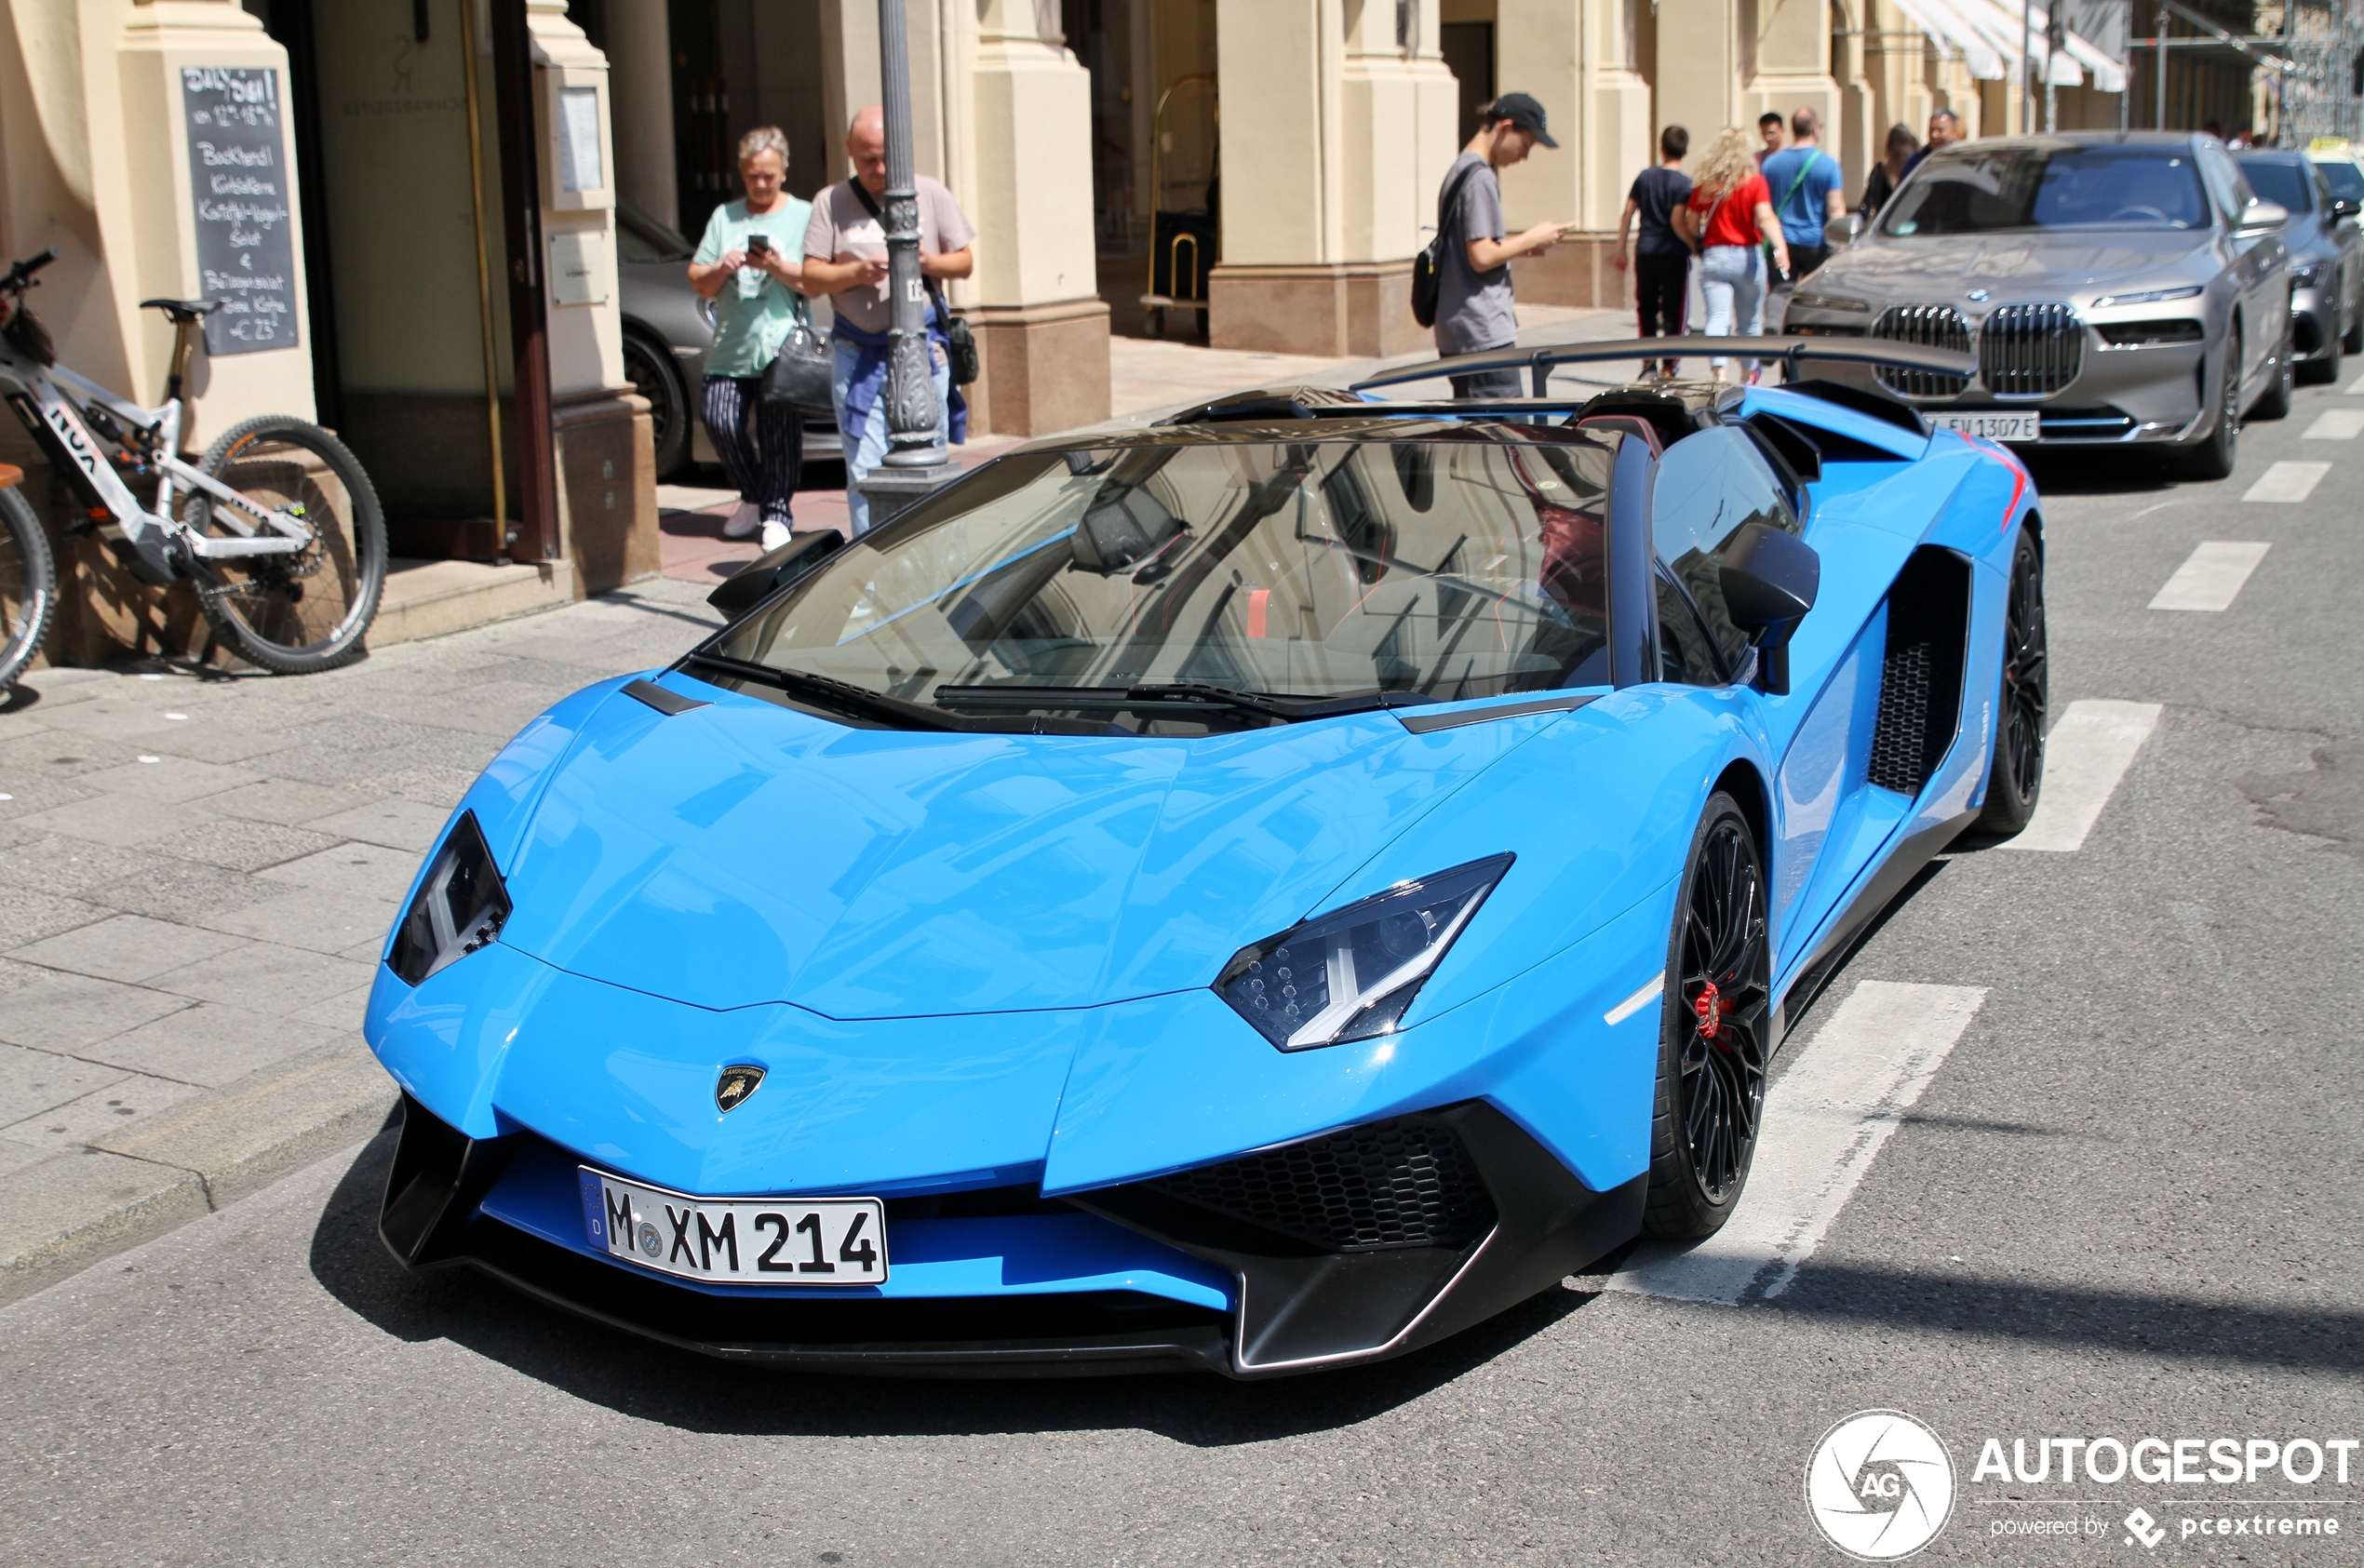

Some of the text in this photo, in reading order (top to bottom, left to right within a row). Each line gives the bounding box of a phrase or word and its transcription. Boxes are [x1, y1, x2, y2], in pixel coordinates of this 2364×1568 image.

[723, 1068, 762, 1079] LAMBORGHINI
[592, 1218, 602, 1235] D
[606, 1186, 636, 1252] M
[665, 1204, 740, 1271] XM
[755, 1213, 877, 1273] 214
